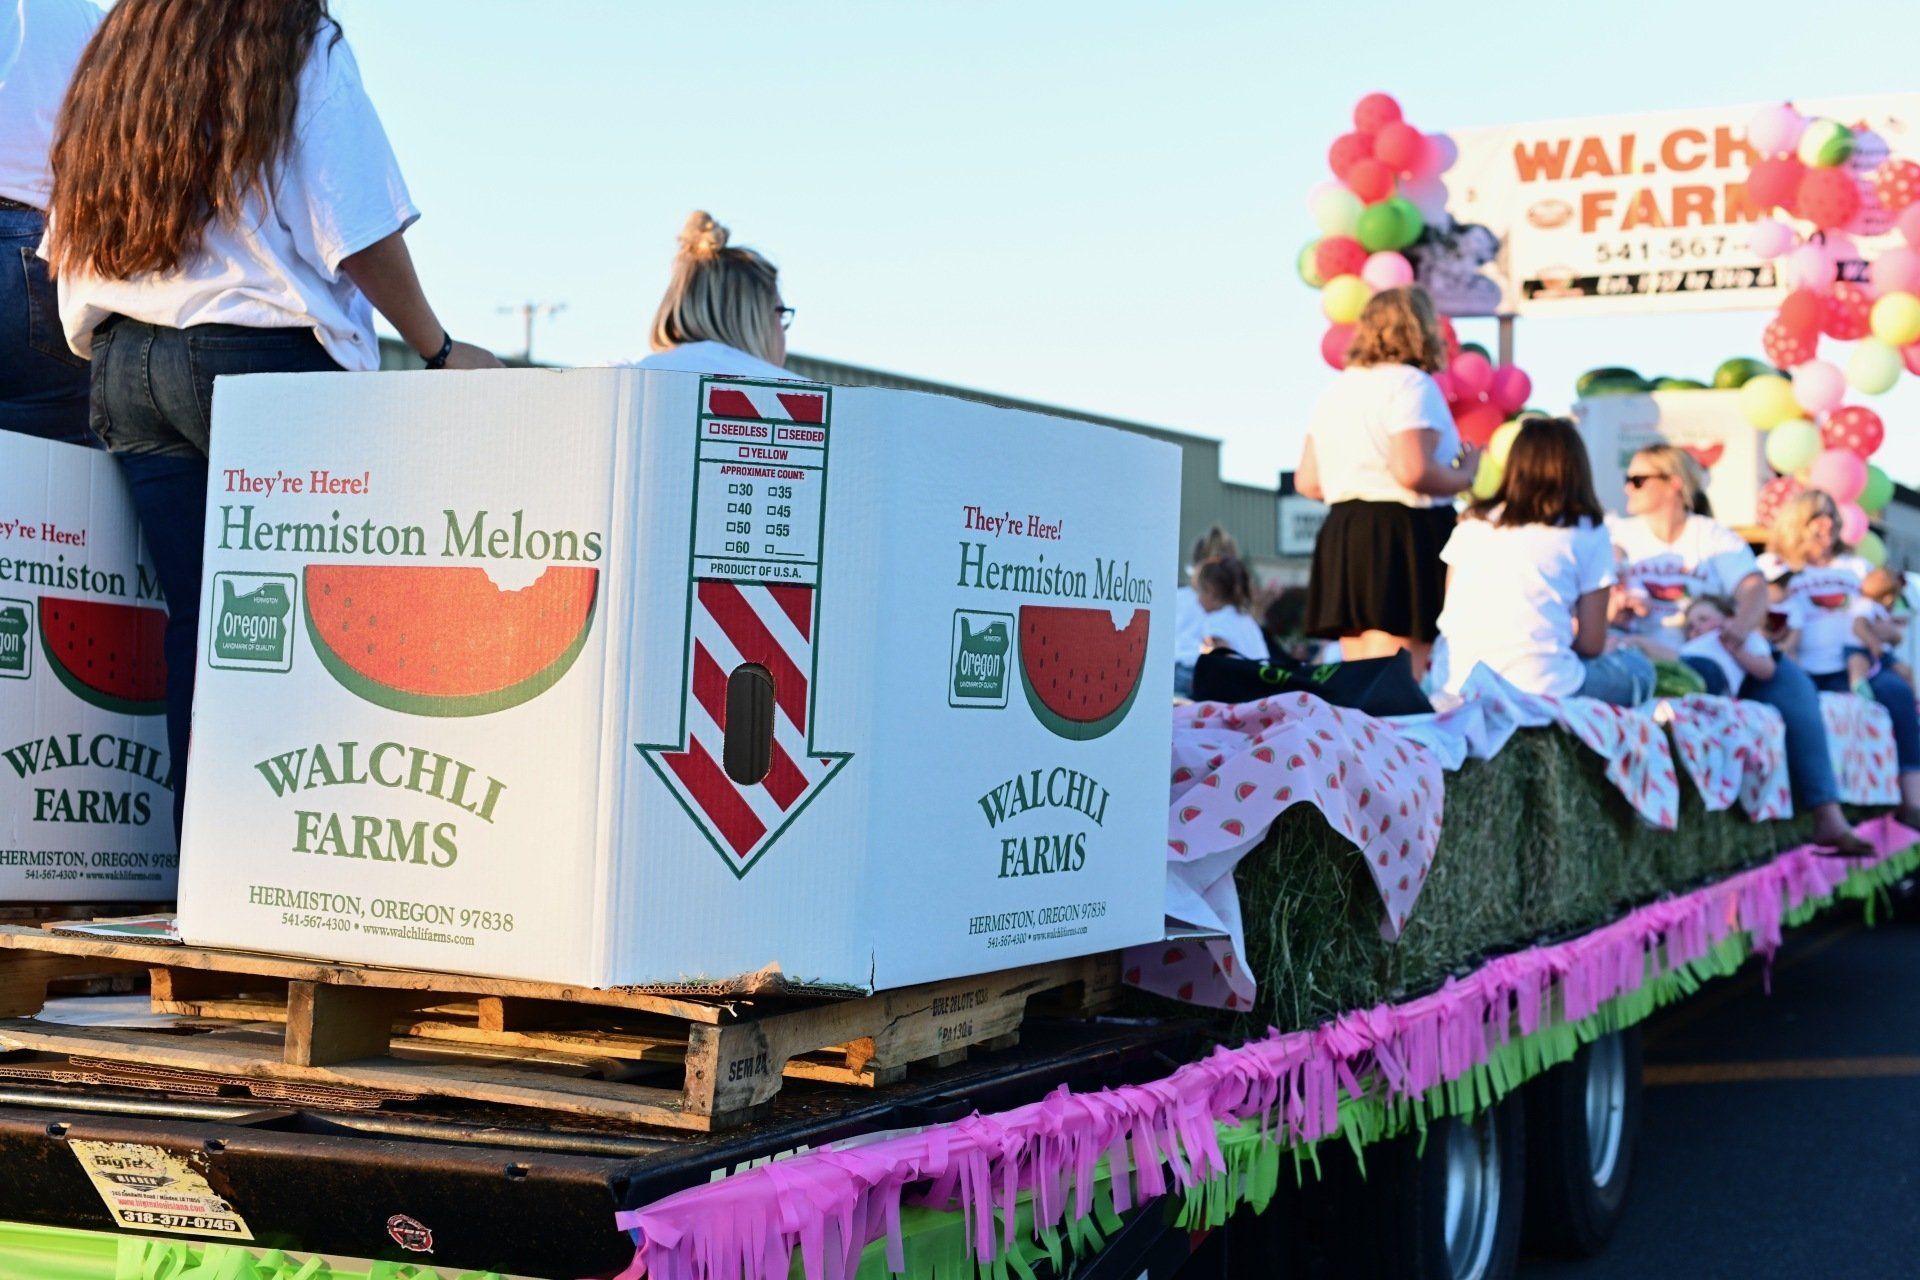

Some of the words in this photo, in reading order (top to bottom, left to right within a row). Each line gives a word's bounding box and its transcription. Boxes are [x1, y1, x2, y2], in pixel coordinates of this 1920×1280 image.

[1513, 126, 1760, 183] WALCH
[1580, 182, 1773, 234] FARM
[721, 424, 768, 438] SEEDLESS
[789, 429, 824, 442] SEEDED
[751, 447, 789, 460] YELLOW
[223, 469, 303, 498] They're
[309, 470, 370, 495] Here!
[720, 465, 776, 478] APPROXIMATE
[777, 469, 805, 480] COUNT:
[738, 483, 753, 496] 30
[778, 486, 792, 499] 35
[737, 502, 752, 515] 40
[777, 505, 791, 518] 45
[963, 505, 1023, 538] They're
[1026, 514, 1063, 540] Here!
[41, 522, 86, 547] Here!
[218, 505, 426, 556] Hermiston
[440, 509, 602, 562] Melons
[736, 521, 751, 534] 50
[775, 524, 790, 537] 55
[735, 541, 750, 554] 60
[0, 554, 126, 596] ermiston
[135, 563, 167, 602] M
[710, 562, 756, 576] PRODUCT
[759, 564, 772, 576] OF
[774, 567, 801, 579] U.S.A.
[957, 541, 1087, 599] Hermiston
[1093, 557, 1153, 605] Melons
[223, 612, 278, 642] Oregon
[222, 642, 248, 650] LANDMARK
[255, 643, 276, 651] QUALITY
[960, 650, 1000, 681] Oregon
[254, 741, 507, 824] WALCHLI
[33, 788, 151, 826] FARMS
[977, 766, 1110, 829] WALCHLI
[292, 809, 458, 868] FARMS
[0, 850, 88, 869] HERMISTON,
[91, 852, 149, 867] OREGON
[152, 854, 180, 869] 9783
[997, 832, 1086, 879] FARMS
[25, 869, 77, 881] 541-567-4300
[249, 885, 366, 919] HERMISTON,
[371, 898, 455, 926] OREGON
[460, 909, 514, 932] 97838
[968, 910, 1036, 935] HERMISTON,
[1038, 903, 1081, 926] OREGON
[1081, 901, 1107, 919] 97838
[281, 912, 351, 932] 541-567-4300
[362, 923, 475, 946] www.walchlifarms.com
[987, 932, 1027, 949] 541-567-4300
[728, 1056, 754, 1082] SEM
[123, 1210, 236, 1231] 318-377-0745
